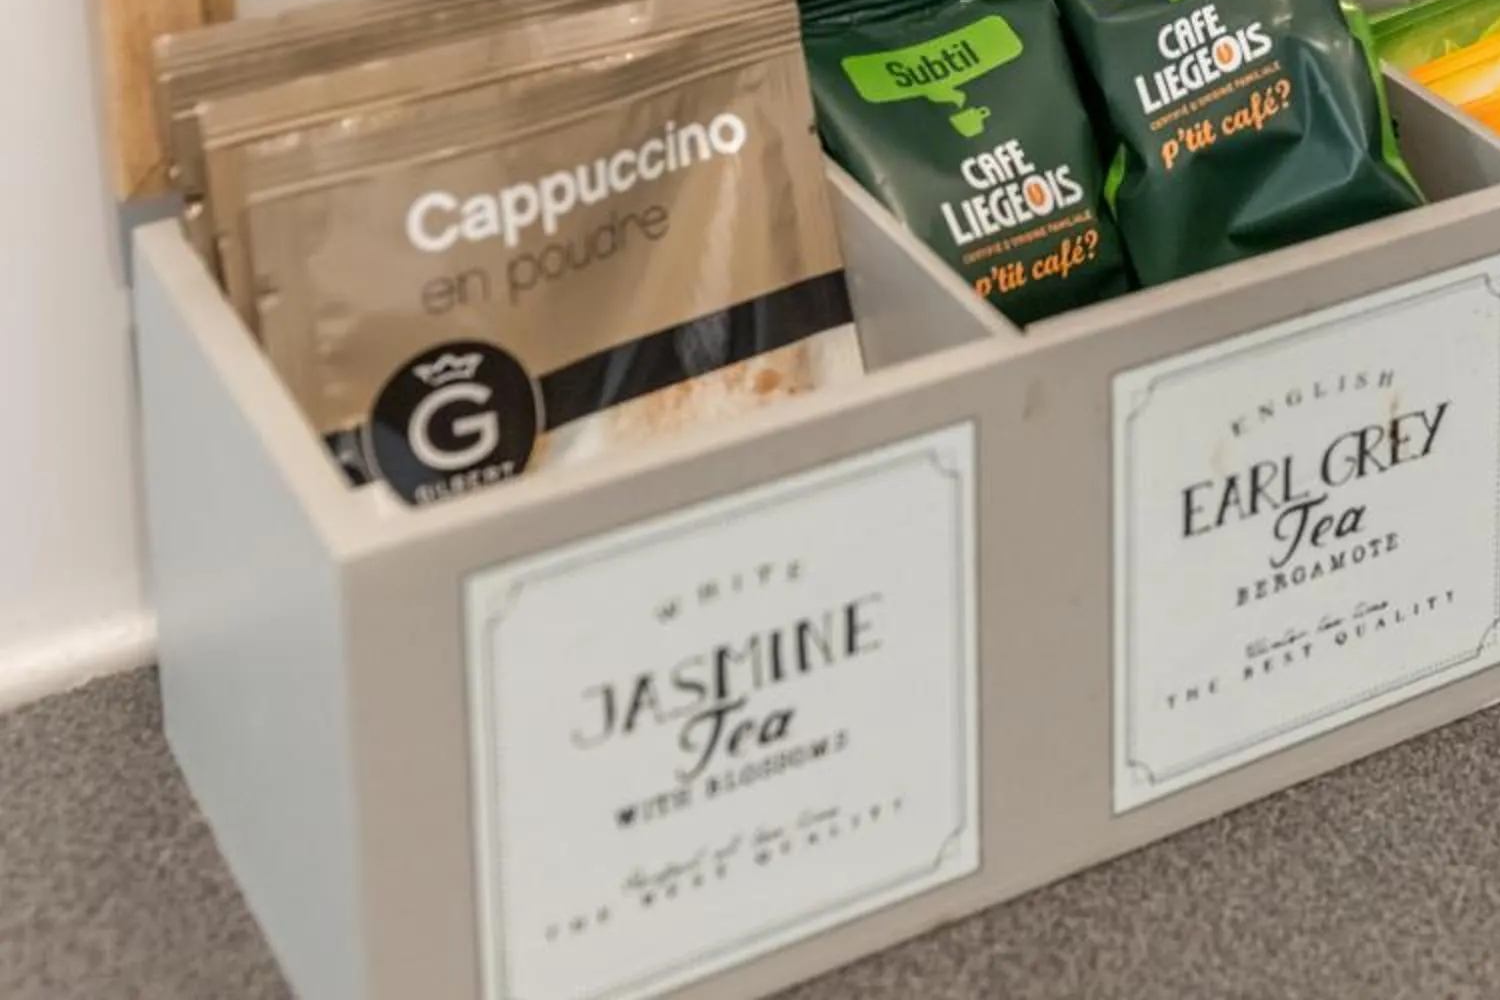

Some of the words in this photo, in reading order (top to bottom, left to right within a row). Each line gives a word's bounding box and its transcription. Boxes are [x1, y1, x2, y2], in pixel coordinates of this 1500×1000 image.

[884, 40, 980, 88] Subtil
[1134, 22, 1272, 115] LIEGEOIS
[1158, 4, 1227, 59] CAFE
[405, 113, 747, 252] Cappuccino
[940, 164, 1083, 246] LIEGEOIS
[961, 138, 1035, 190] CAFE
[421, 265, 491, 316] en
[507, 204, 671, 305] poudre
[408, 381, 499, 471] G
[1230, 369, 1395, 438] ENGLISH
[1181, 455, 1312, 539] EARL
[1320, 399, 1453, 487] GREY
[1236, 531, 1400, 607] BERGAMOTE
[1269, 492, 1366, 569] Tea
[570, 591, 884, 750] JASMINE
[673, 695, 796, 784] Tea
